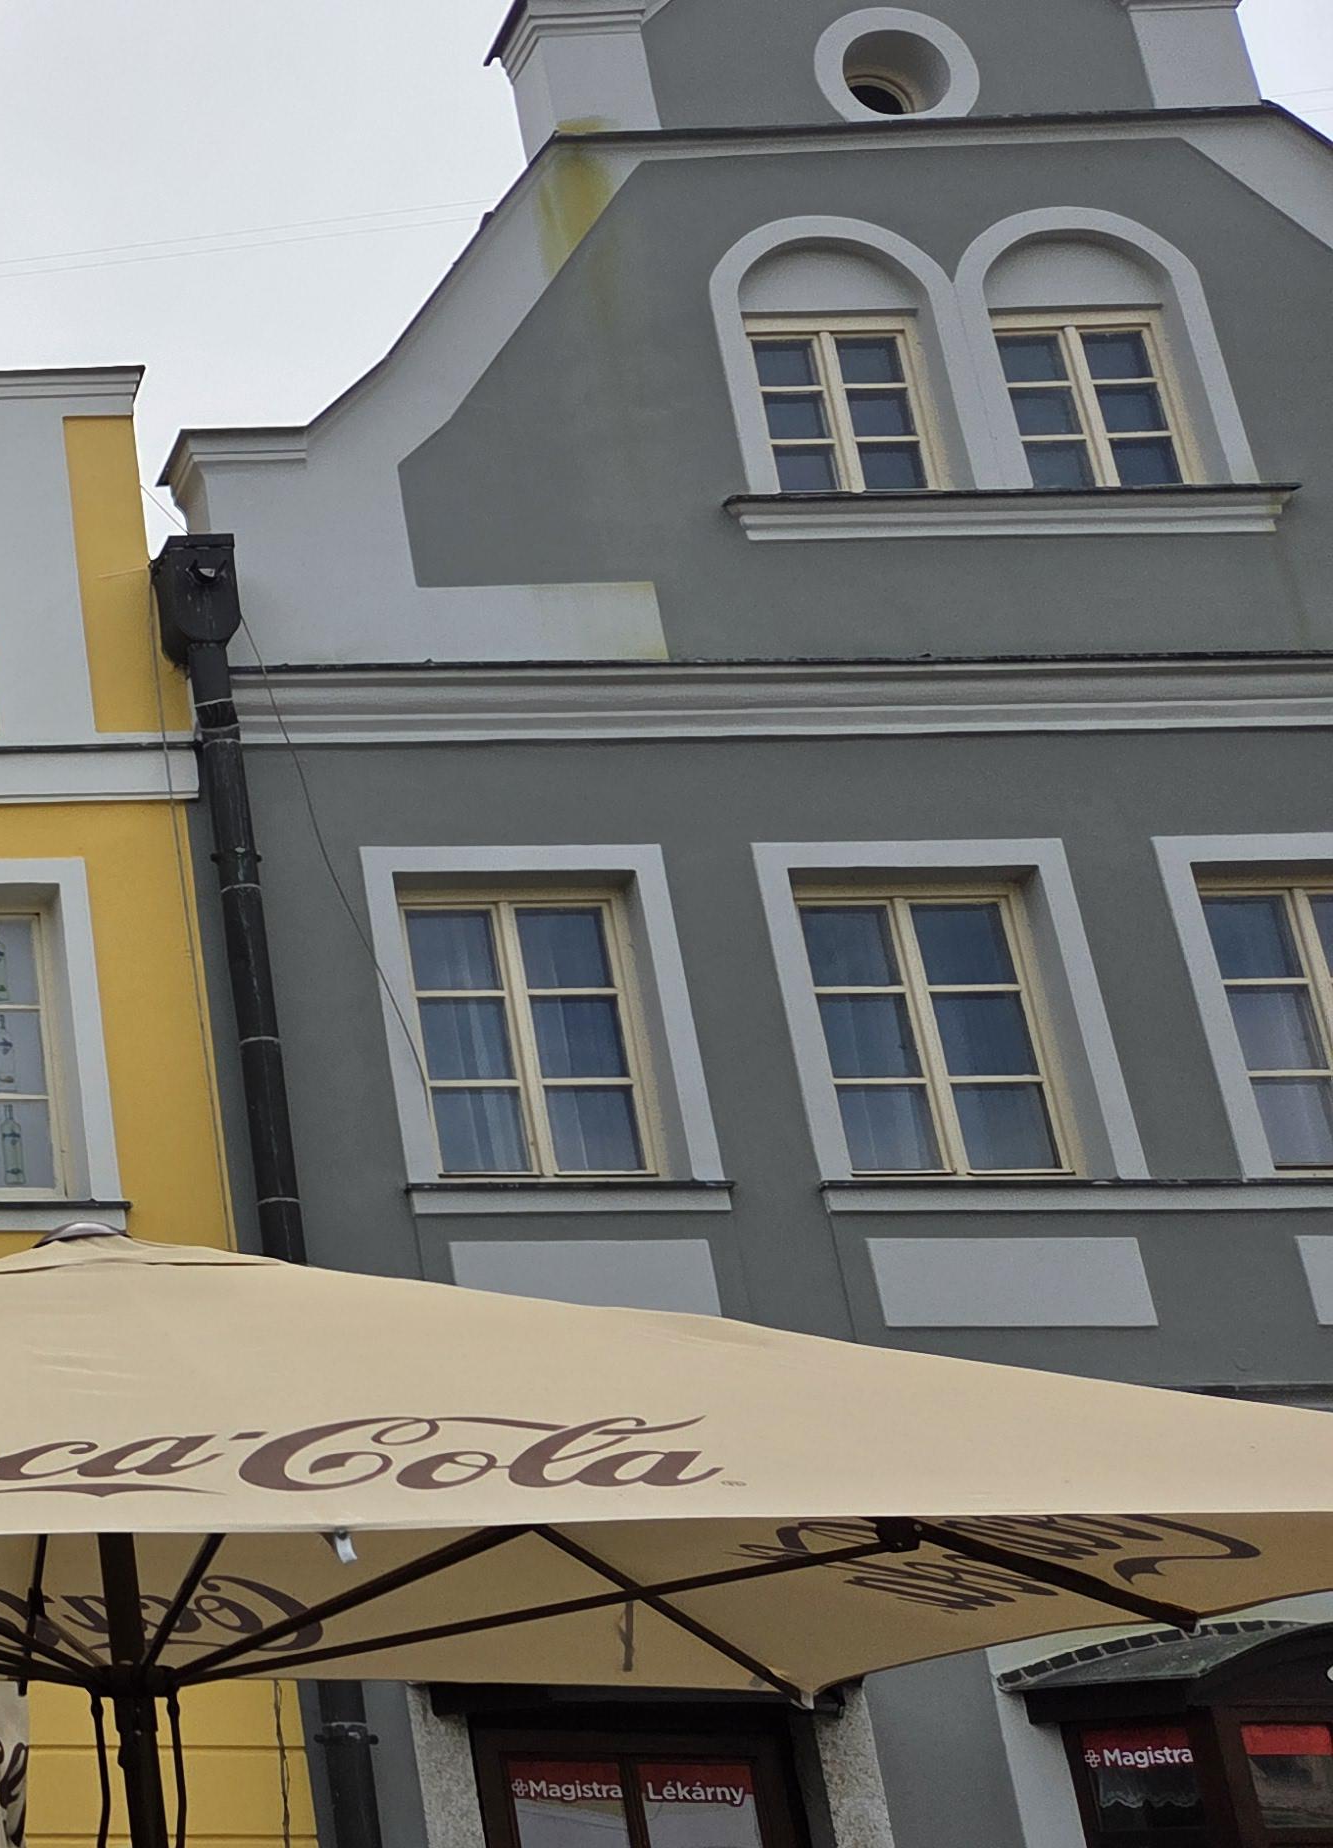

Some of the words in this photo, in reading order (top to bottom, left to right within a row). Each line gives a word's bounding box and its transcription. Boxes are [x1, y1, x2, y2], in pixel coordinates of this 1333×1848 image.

[1103, 1746, 1194, 1768] Magistra
[529, 1779, 623, 1801] Magistra
[647, 1780, 745, 1805] Lékárny
